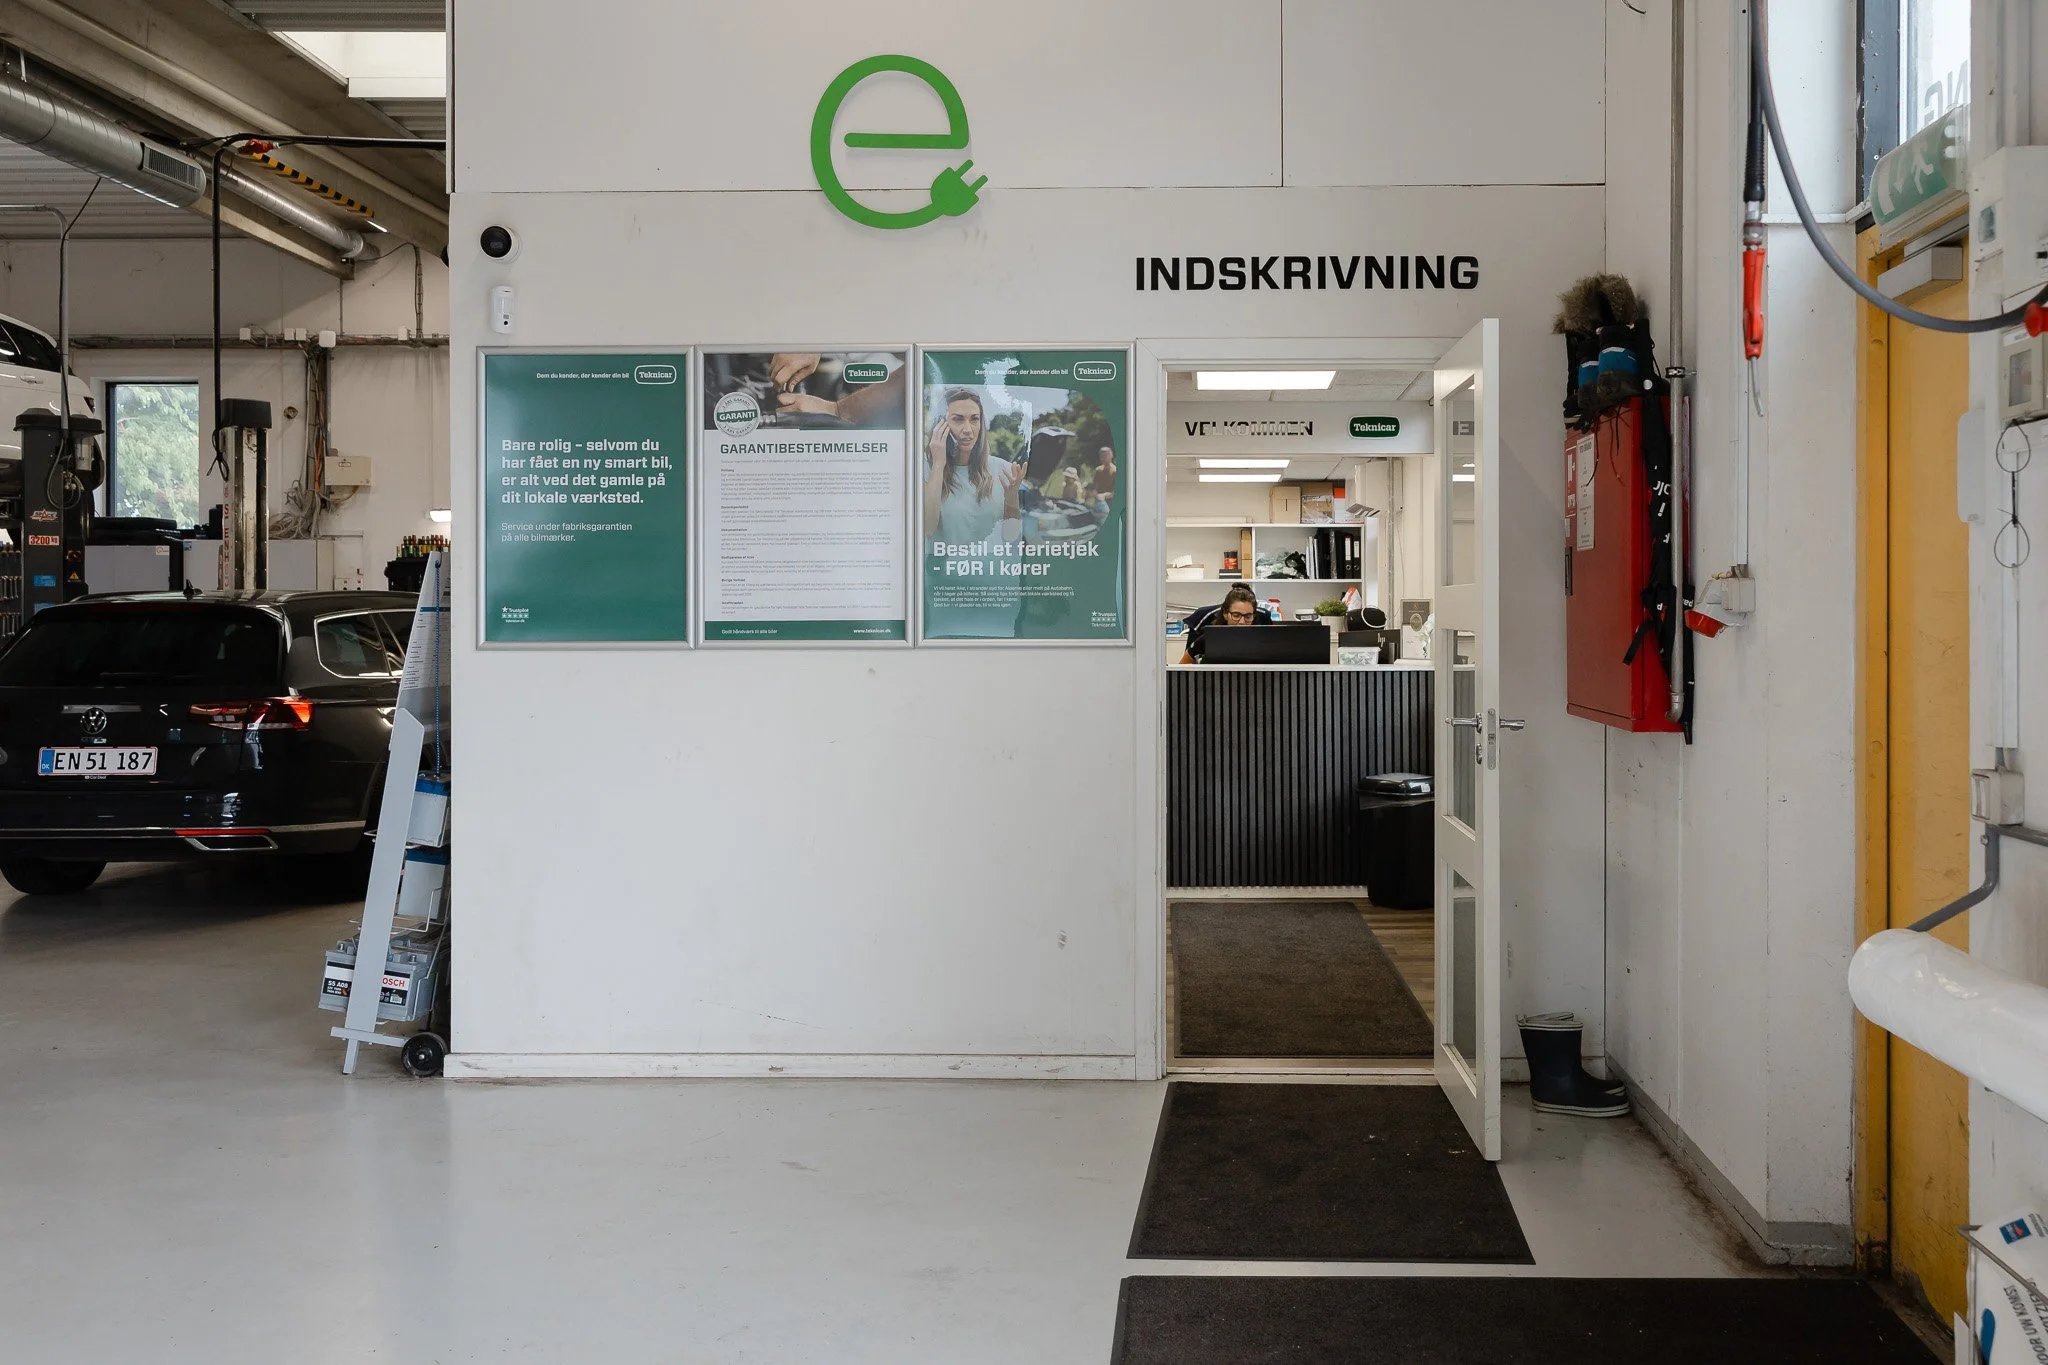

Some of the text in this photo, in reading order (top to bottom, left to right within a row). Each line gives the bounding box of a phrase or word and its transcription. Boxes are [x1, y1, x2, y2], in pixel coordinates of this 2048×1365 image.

[1136, 255, 1479, 290] INDSKRIVNING
[848, 368, 885, 377] Teknicar
[719, 412, 755, 421] GARANTI
[1185, 421, 1313, 436] VELKOMMEN
[1354, 423, 1396, 432] Teknicar
[502, 440, 535, 450] Bare
[540, 438, 571, 453] rolig
[586, 438, 637, 450] selvom
[642, 438, 659, 450] du
[720, 442, 888, 454] GARANTIBESTEMMELSER
[502, 455, 672, 470] har fået en ny smart bil,
[502, 472, 665, 488] er alt ved det gamle på
[502, 491, 643, 503] dit lokale værksted.
[562, 522, 632, 532] fabriksgarantien
[31, 536, 50, 545] 3200
[502, 533, 576, 542] på alle bilmærker.
[934, 541, 1099, 560] Bestil et ferietjek
[946, 560, 983, 576] FØR
[989, 561, 993, 575] I
[1000, 560, 1050, 576] kører
[55, 752, 152, 770] EN 51 187
[382, 978, 405, 988] OSCH
